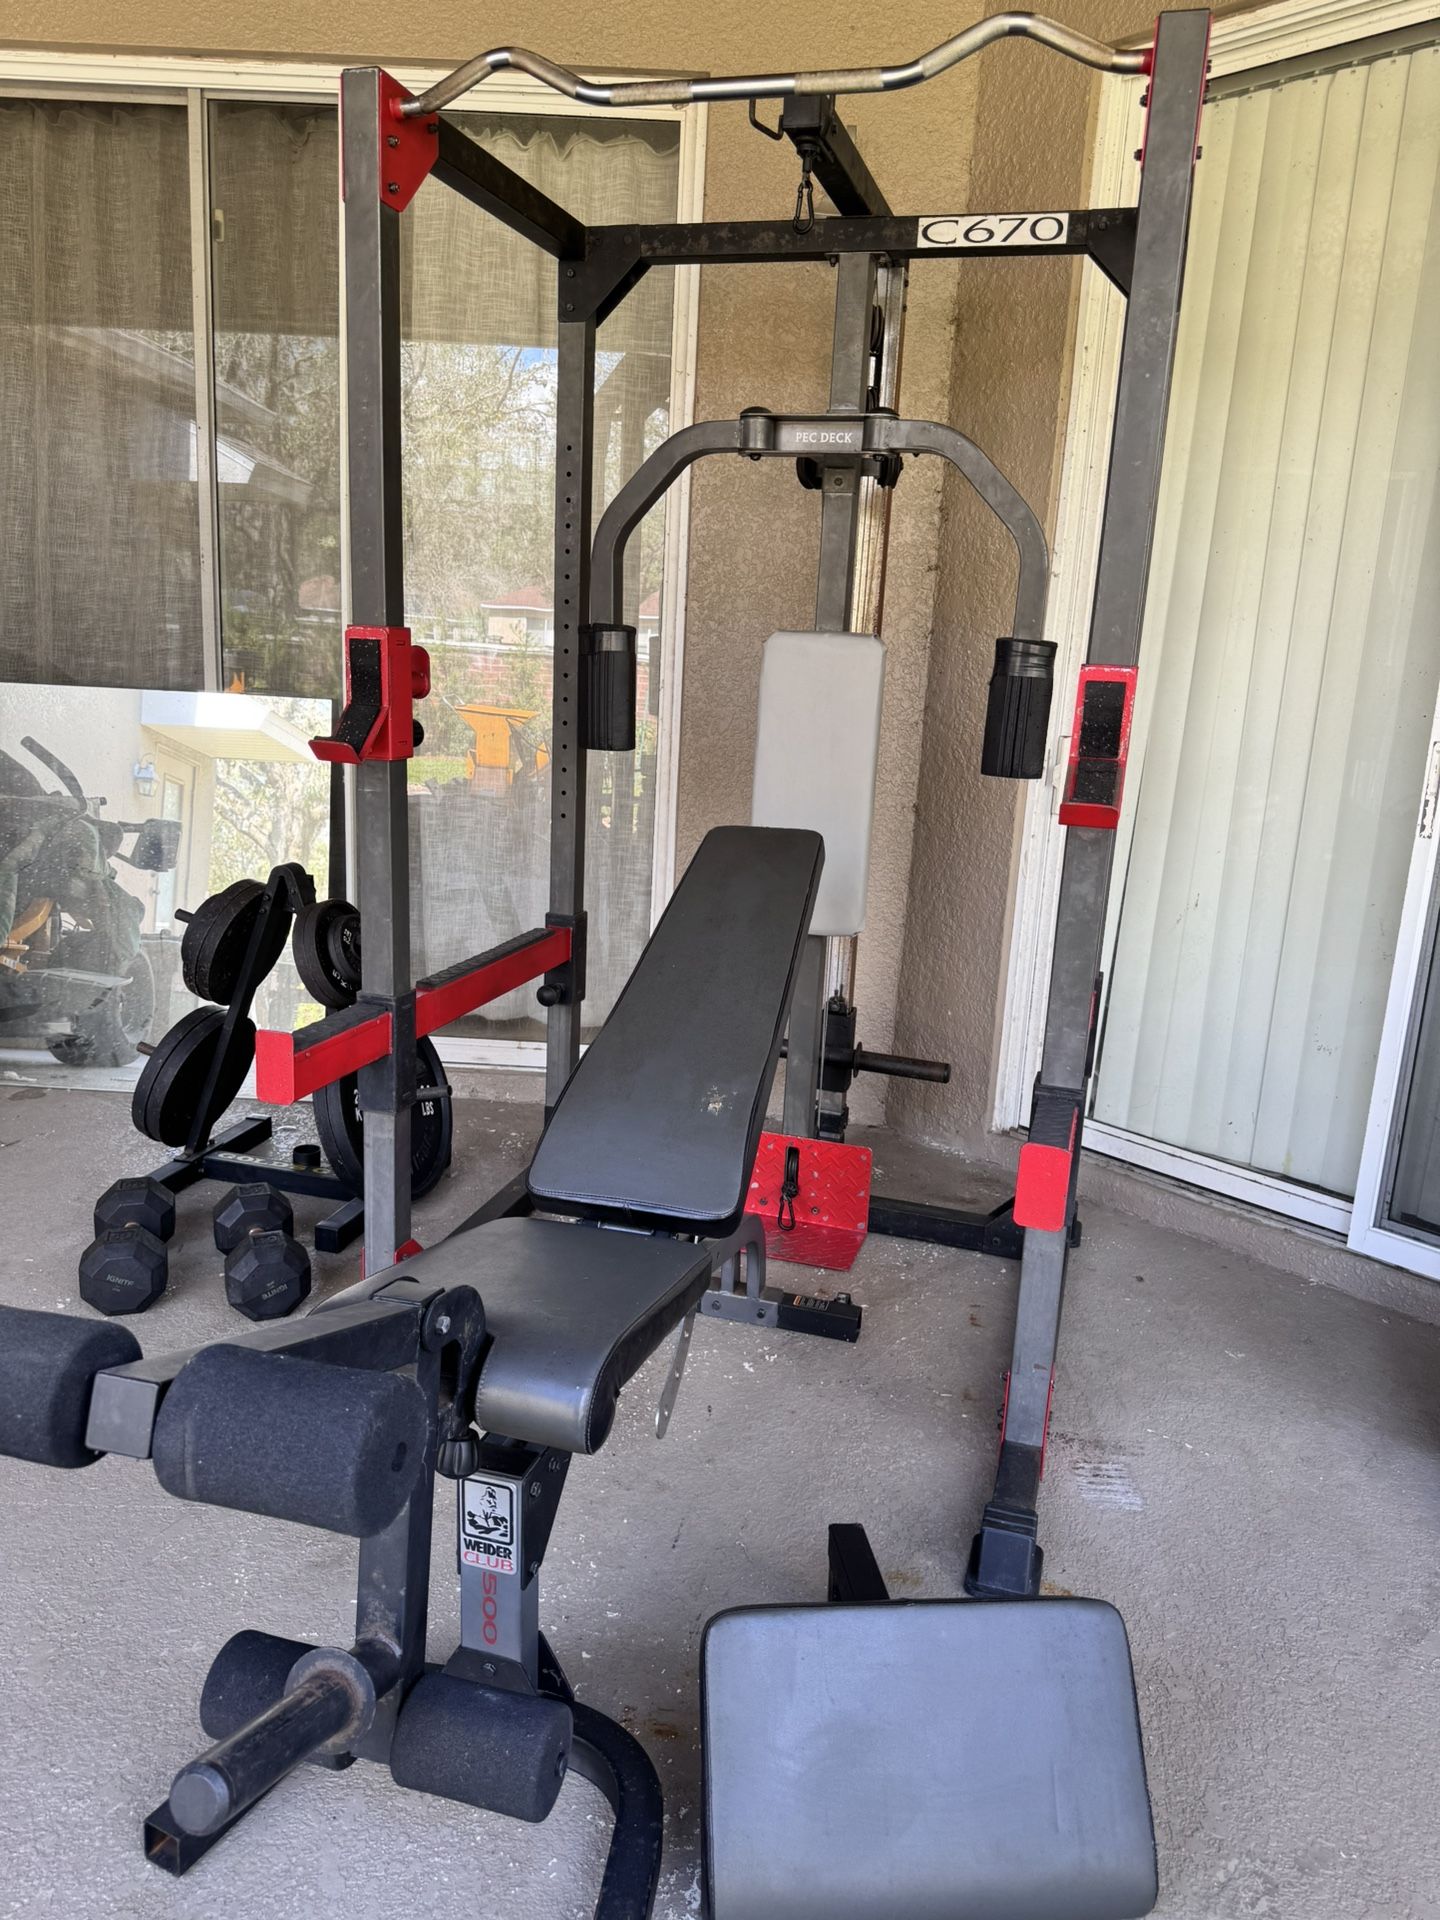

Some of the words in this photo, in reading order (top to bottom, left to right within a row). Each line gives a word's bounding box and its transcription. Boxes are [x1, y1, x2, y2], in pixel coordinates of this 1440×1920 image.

[921, 216, 1064, 245] C670
[796, 432, 817, 443] PEC
[821, 432, 853, 443] DECK
[421, 1101, 435, 1116] LBS
[463, 1537, 512, 1560] WEIDER
[463, 1551, 513, 1572] CLUB
[481, 1571, 497, 1646] 500
